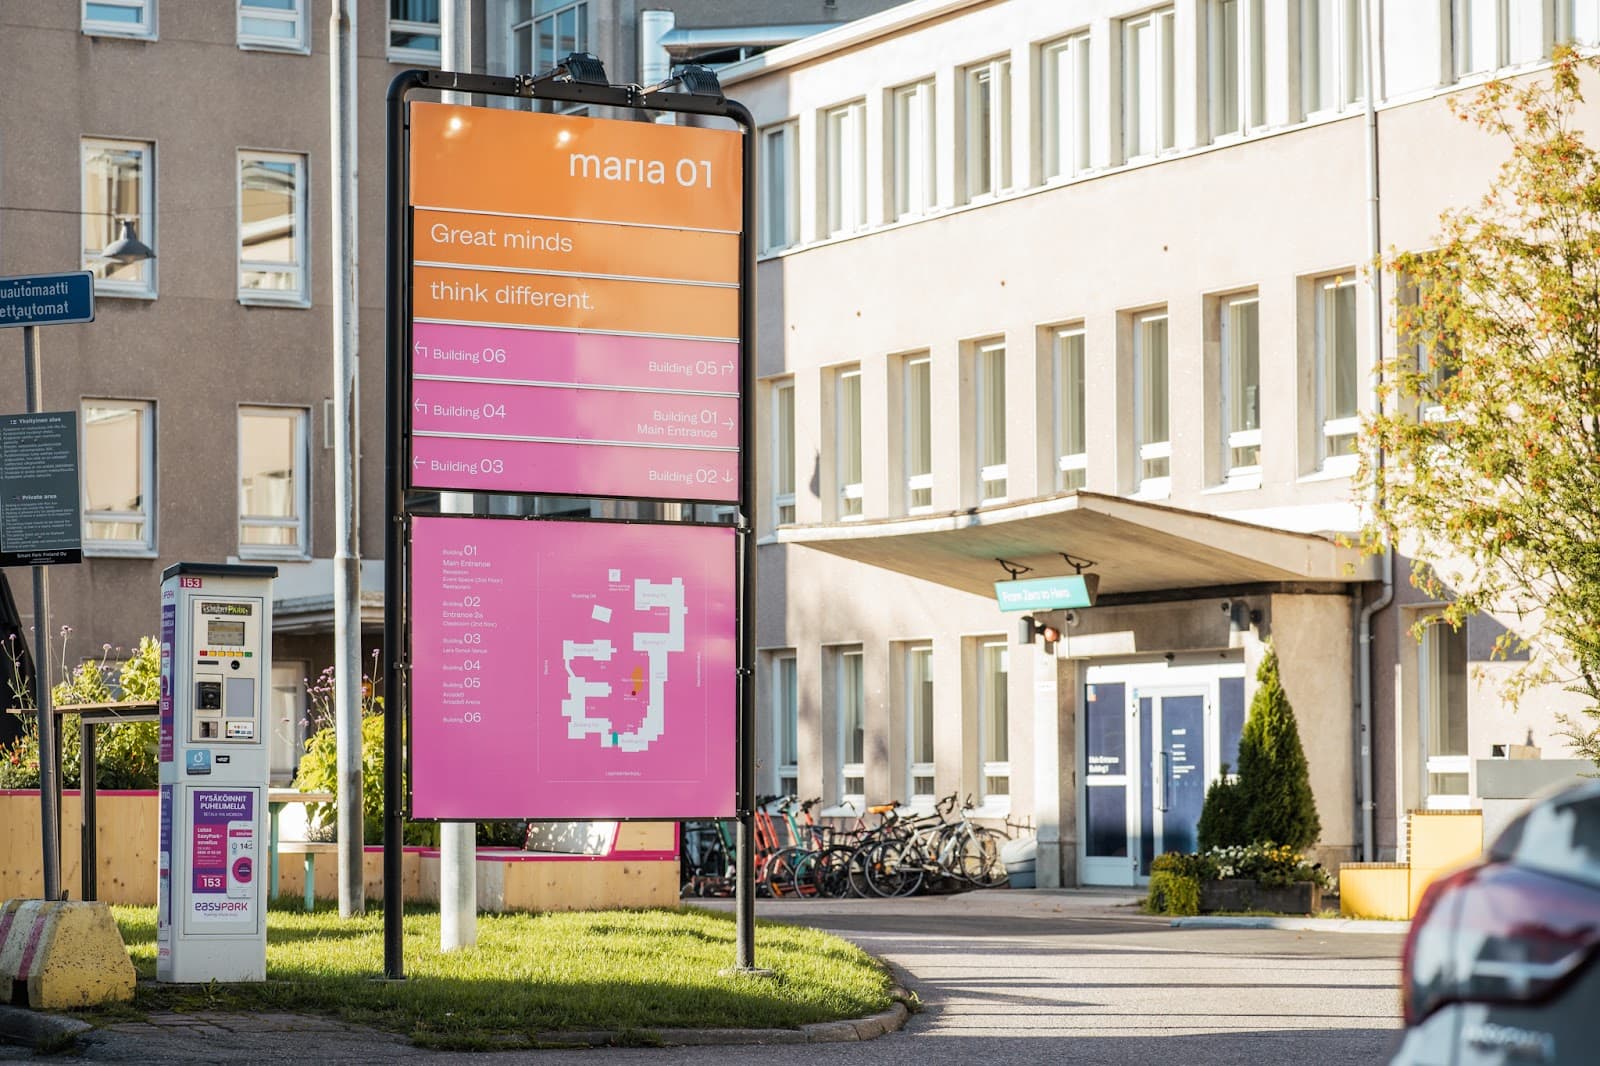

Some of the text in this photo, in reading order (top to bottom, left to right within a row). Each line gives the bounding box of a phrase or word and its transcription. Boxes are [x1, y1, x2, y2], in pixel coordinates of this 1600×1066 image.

[569, 153, 712, 189] maria 01
[430, 223, 573, 252] Great minds
[429, 280, 594, 310] think different.
[433, 347, 506, 364] Building 06
[648, 360, 718, 376] Building 05
[433, 403, 507, 420] Building 04
[653, 409, 718, 425] Building 01
[637, 423, 718, 438] Main Entrance
[431, 458, 504, 475] Building 03
[648, 468, 718, 484] Building 02
[464, 544, 477, 557] 01
[442, 559, 460, 567] Main
[183, 578, 200, 588] 153
[464, 596, 481, 607] 02
[464, 633, 481, 645] 03
[464, 660, 481, 671] 04
[464, 677, 481, 688] 05
[464, 712, 482, 723] 06
[200, 802, 247, 811] PUHELIMELLA
[202, 878, 222, 888] 153
